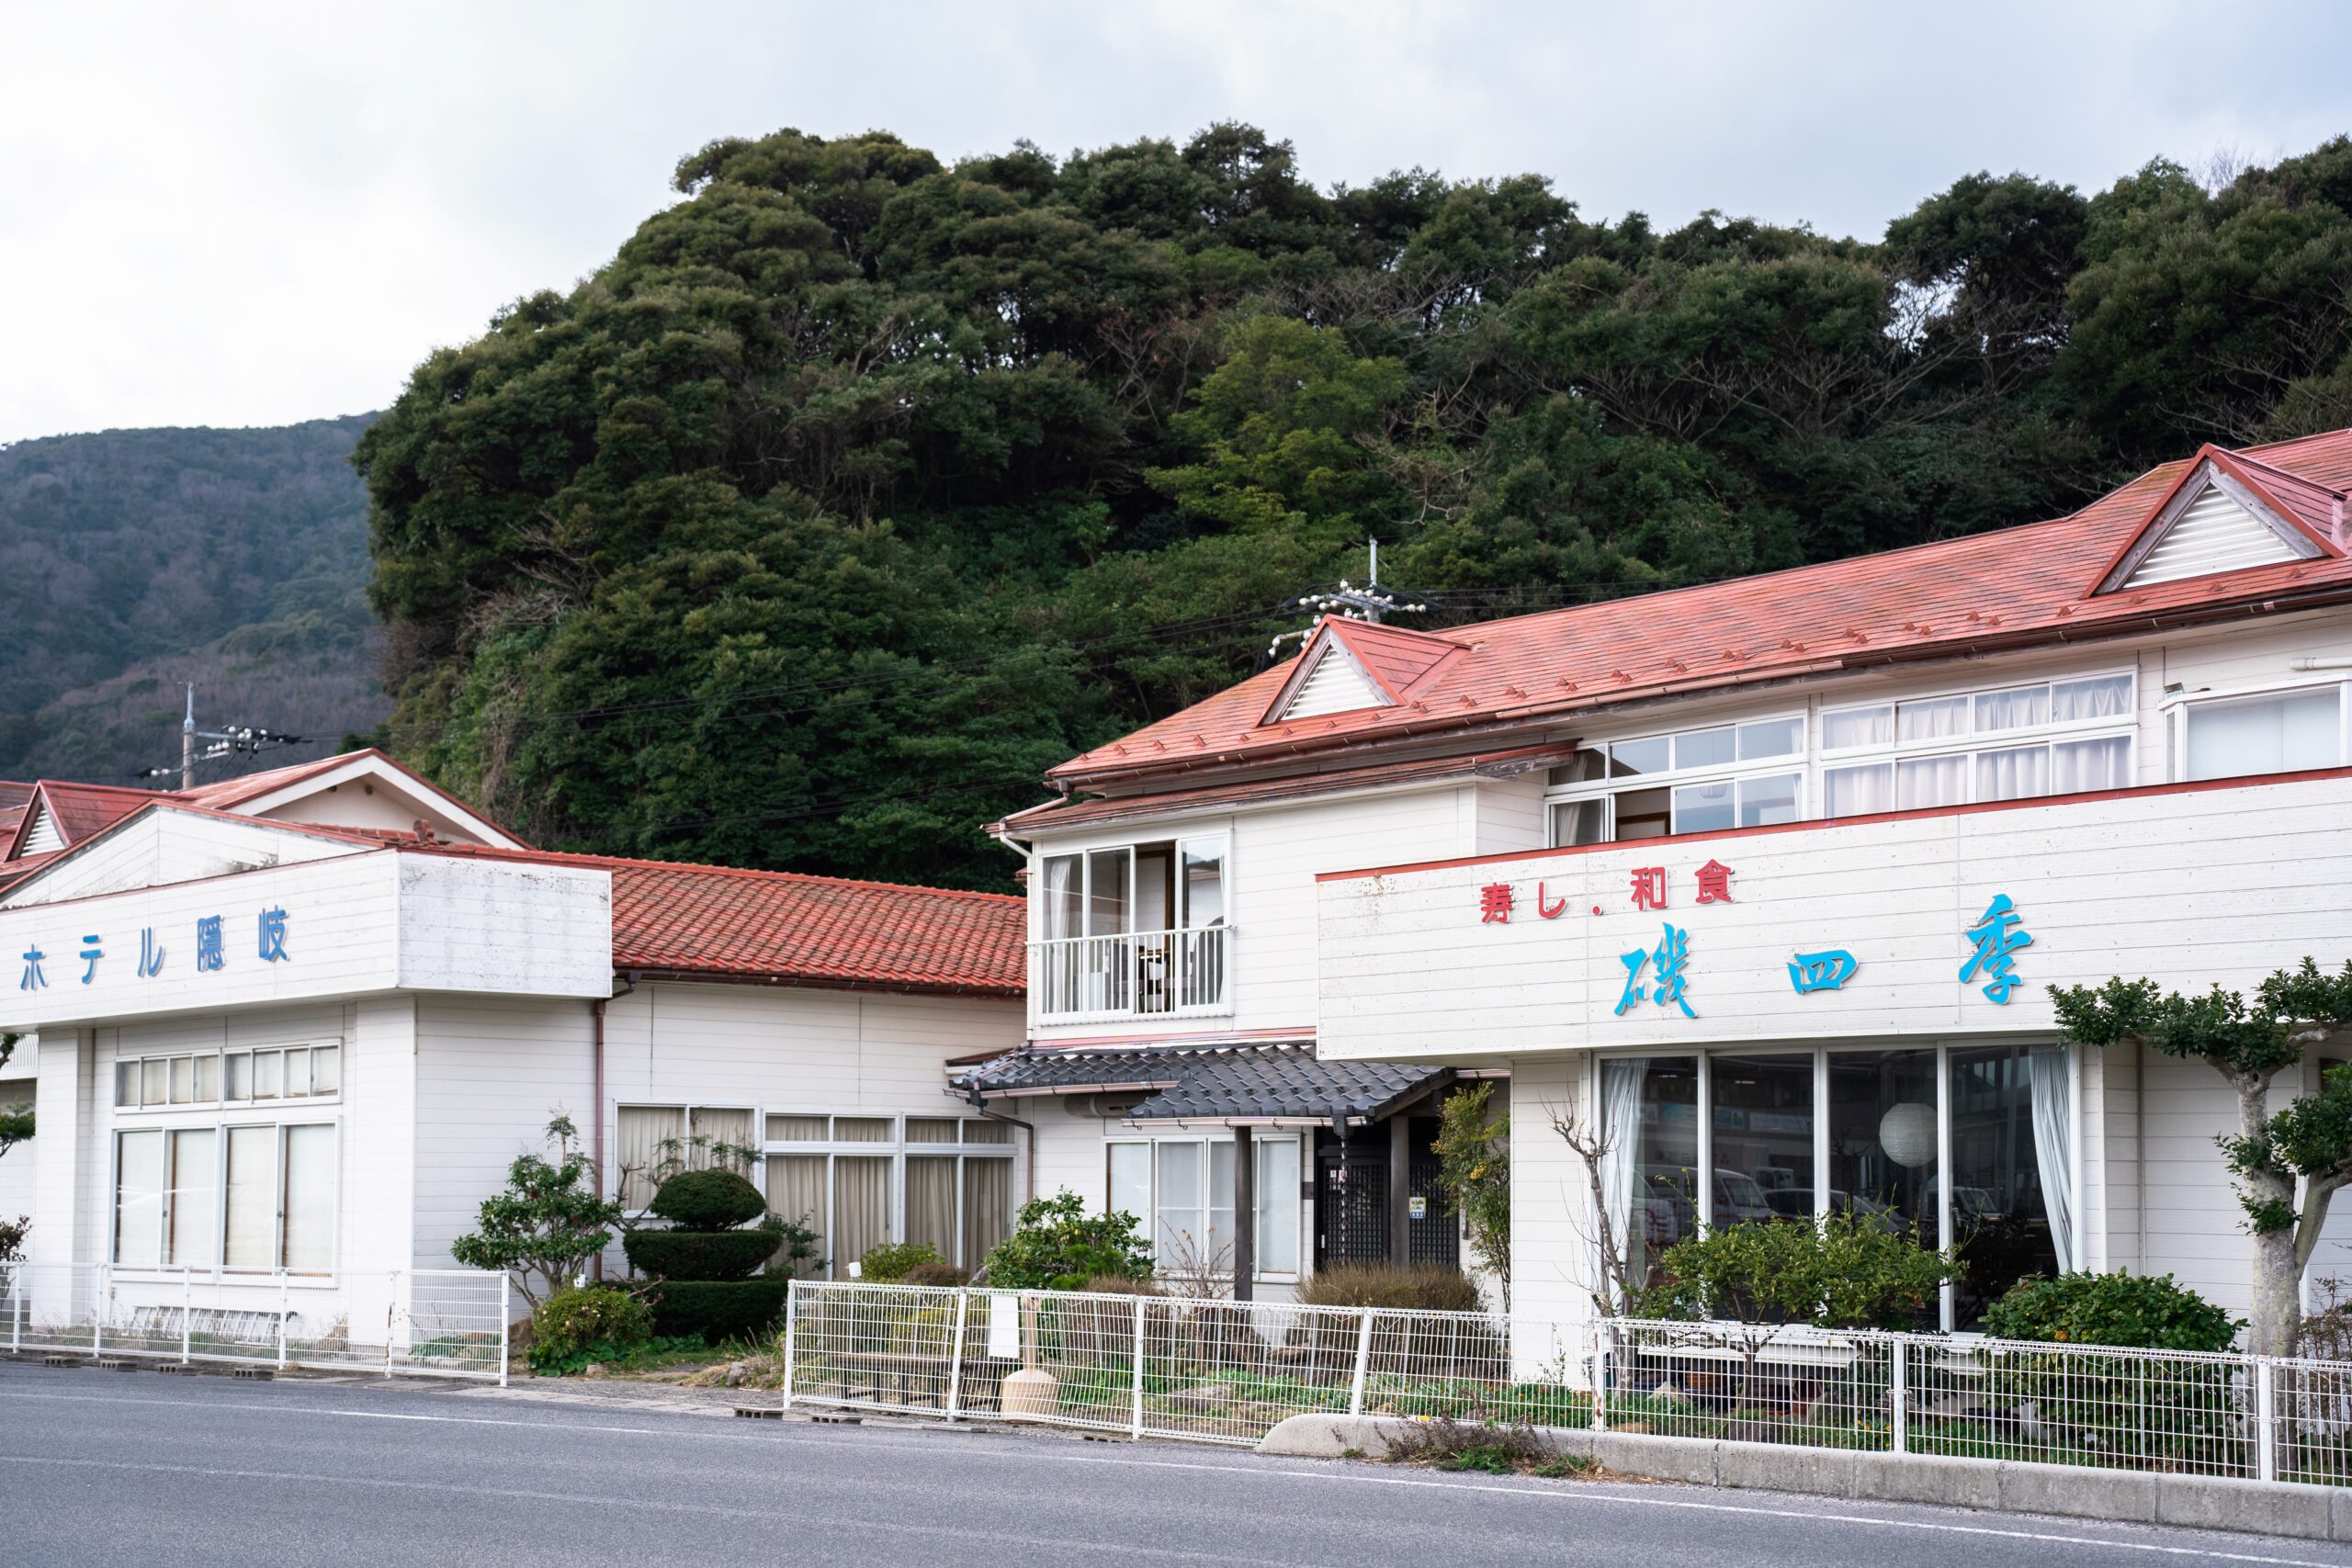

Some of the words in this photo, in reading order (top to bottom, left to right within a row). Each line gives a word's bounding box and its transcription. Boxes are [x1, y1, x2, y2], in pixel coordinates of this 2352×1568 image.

[20, 904, 289, 990] ホテル隠岐
[1614, 893, 2033, 1019] 磯四季
